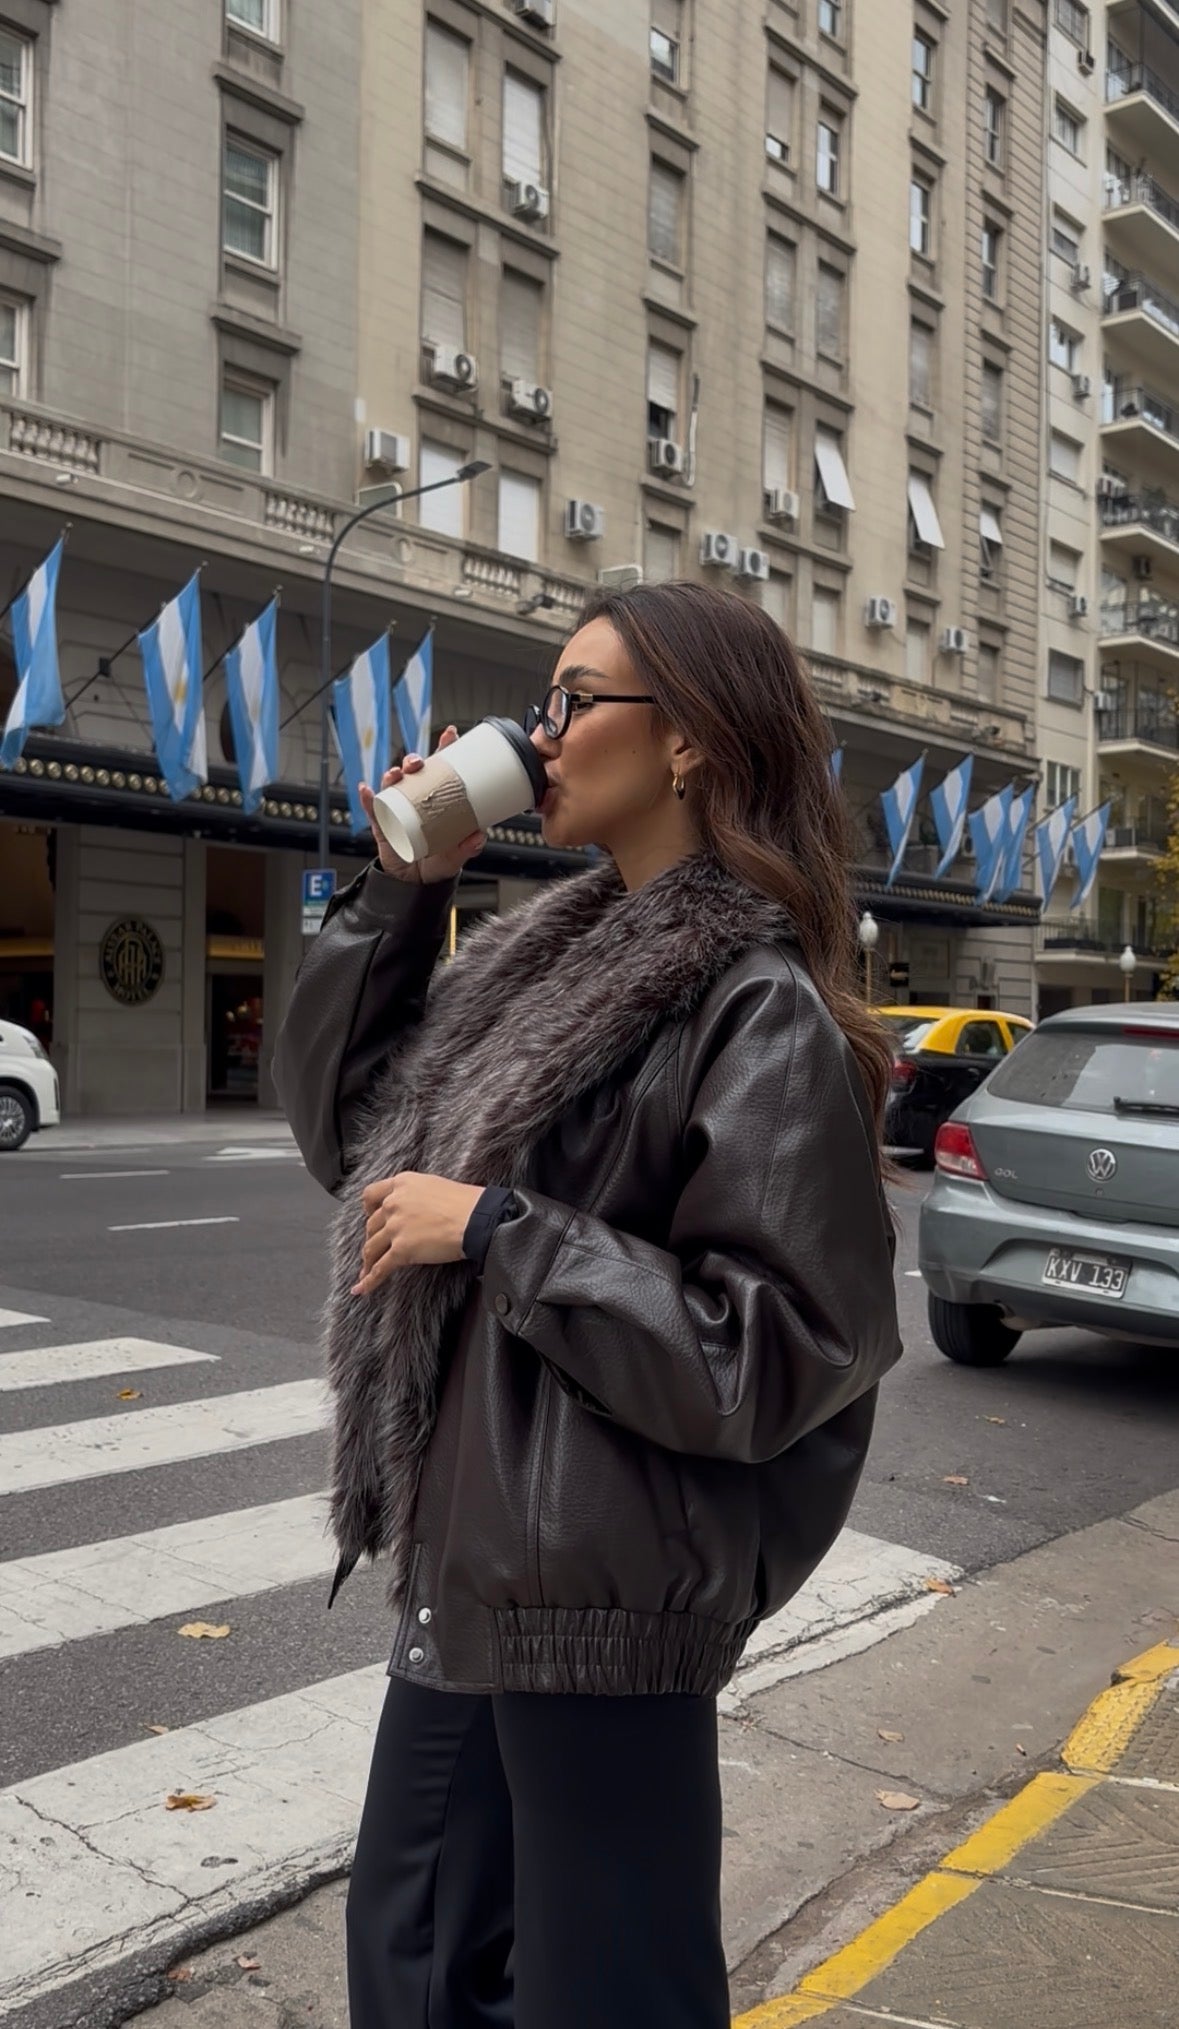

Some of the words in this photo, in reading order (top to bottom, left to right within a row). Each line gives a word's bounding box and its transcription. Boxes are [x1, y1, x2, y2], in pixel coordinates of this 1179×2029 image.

[310, 875, 323, 897] E
[994, 1167, 1019, 1180] GOL
[1047, 1257, 1082, 1282] KXV
[1088, 1265, 1125, 1291] 133
